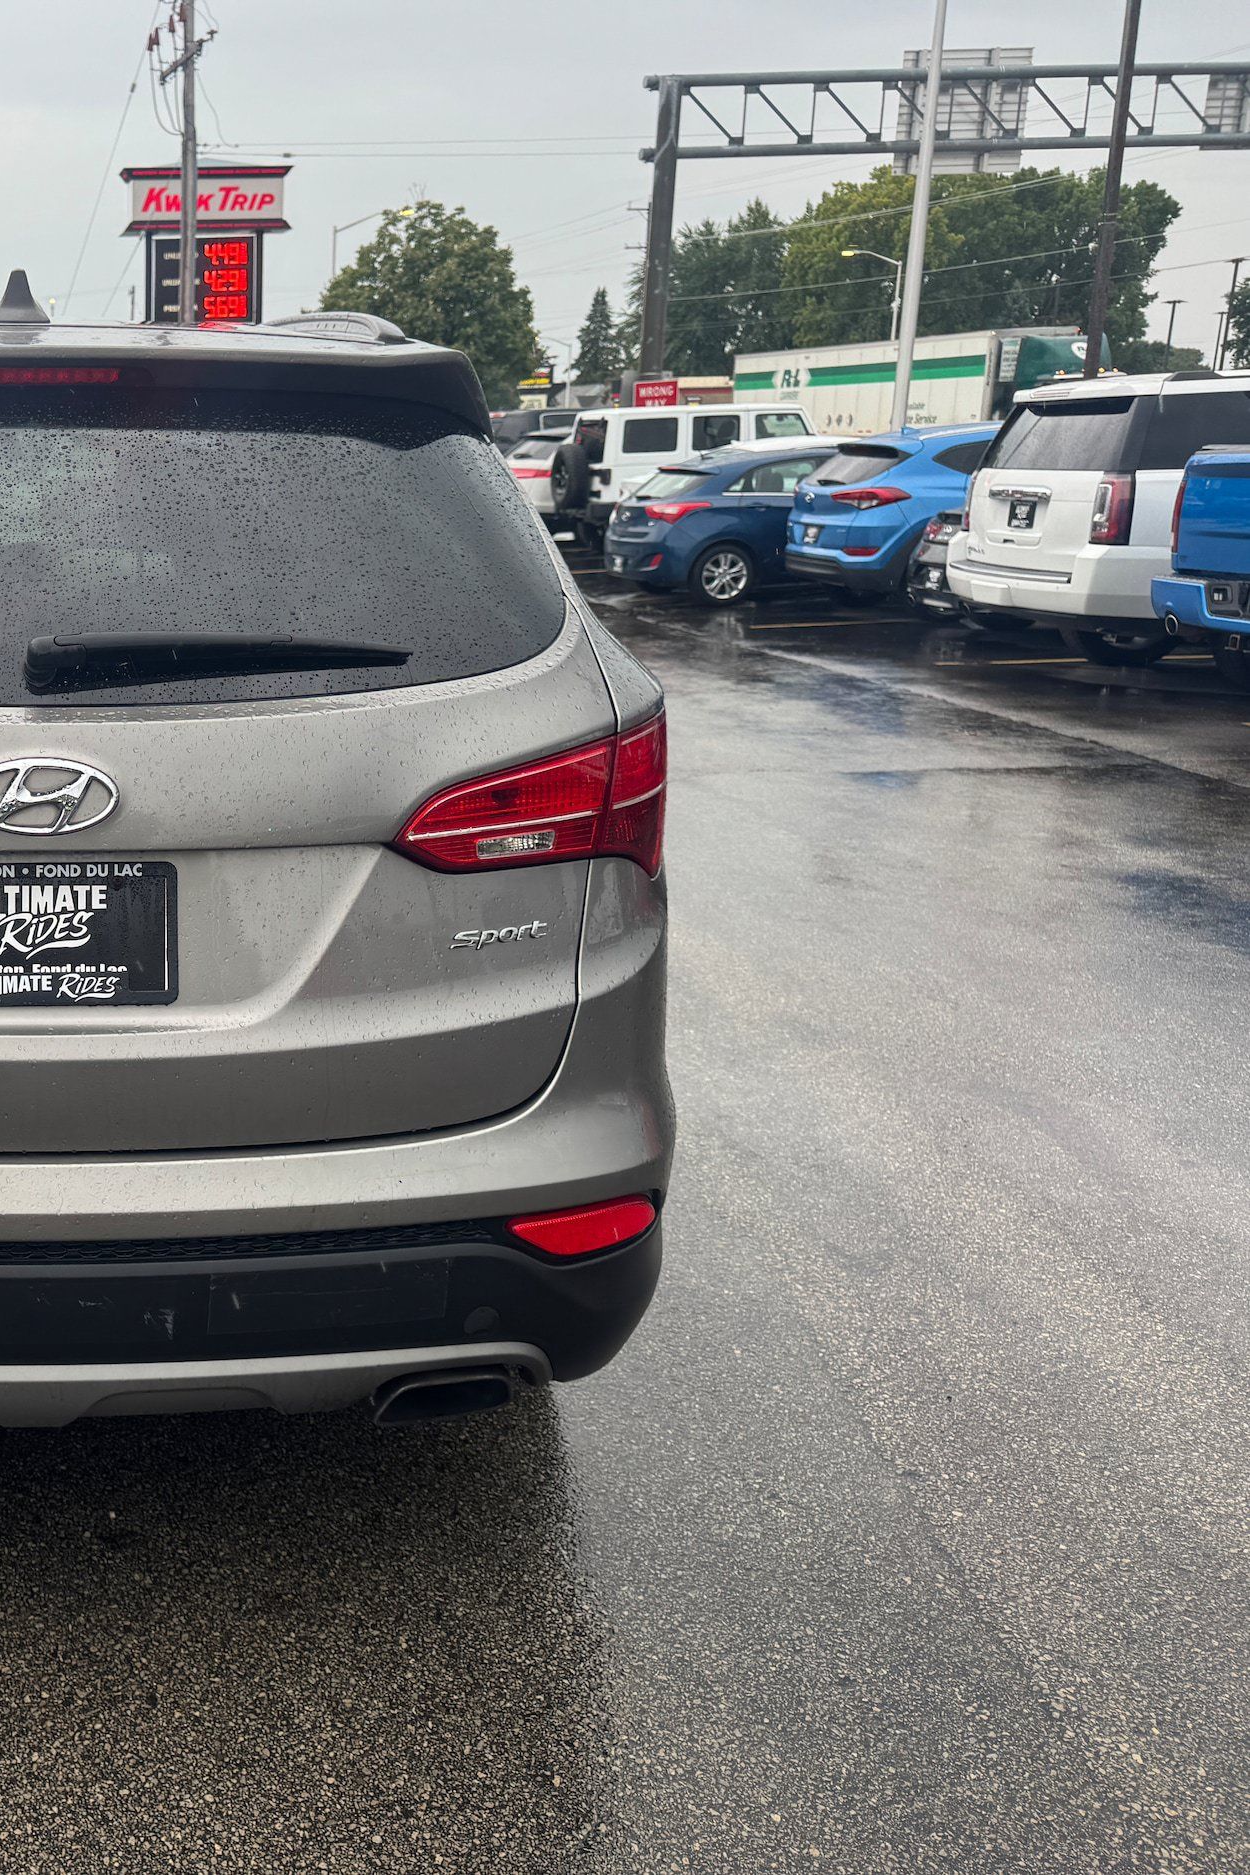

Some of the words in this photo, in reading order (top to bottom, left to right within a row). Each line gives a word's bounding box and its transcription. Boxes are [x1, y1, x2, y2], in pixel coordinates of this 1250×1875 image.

[141, 187, 215, 213] KWK
[218, 186, 276, 212] TRIP
[638, 384, 674, 397] WRONG
[35, 865, 82, 878] FOND
[86, 864, 109, 877] DU
[113, 863, 144, 878] LAC
[449, 920, 548, 950] Sport
